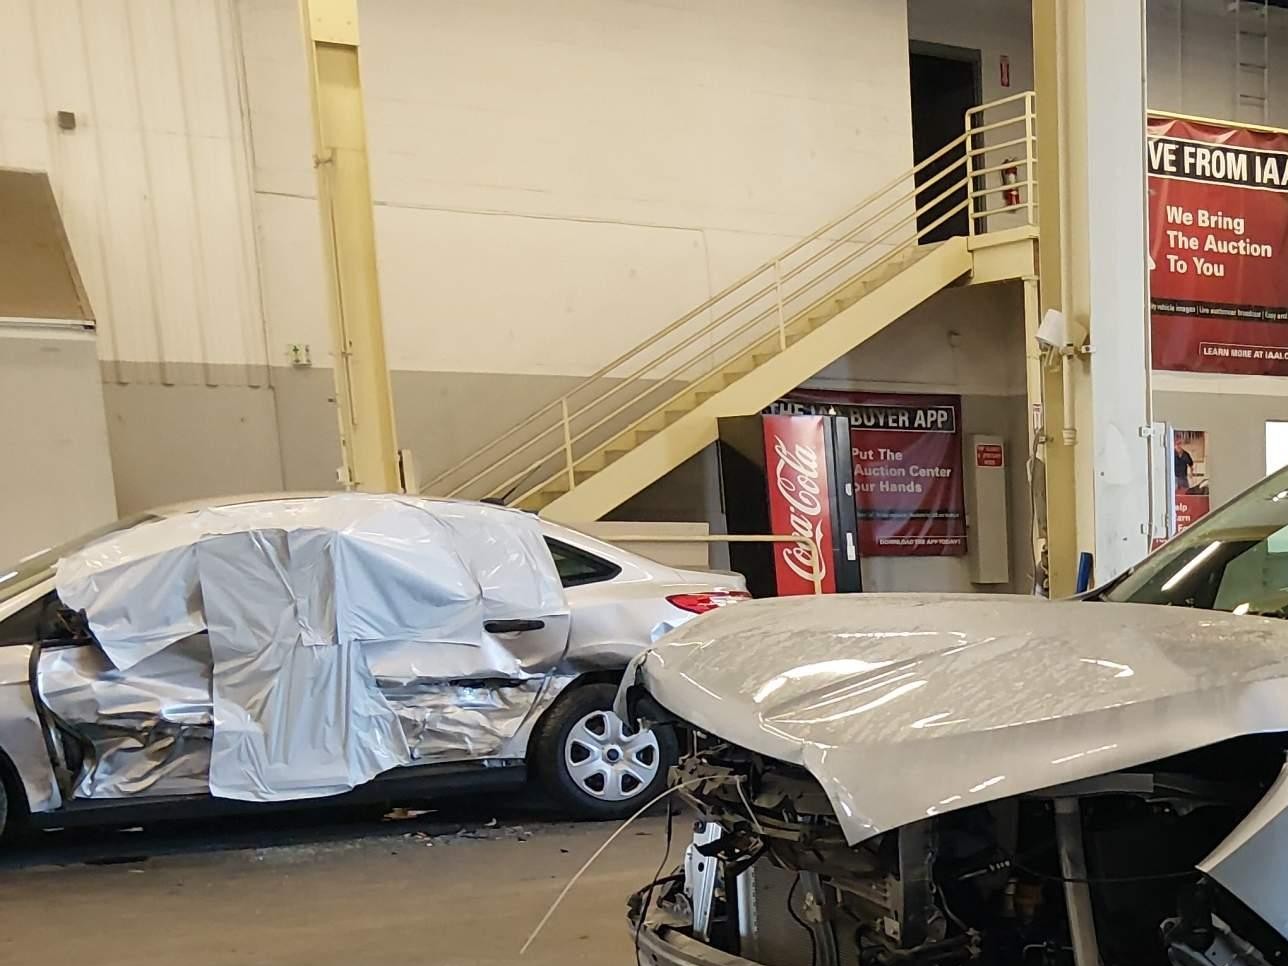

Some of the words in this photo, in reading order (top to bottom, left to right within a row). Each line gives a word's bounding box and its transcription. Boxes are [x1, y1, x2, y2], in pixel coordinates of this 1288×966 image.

[1183, 147, 1248, 181] FROM
[1166, 205, 1193, 225] We
[1198, 209, 1245, 234] Bring
[1166, 230, 1199, 250] The
[1204, 234, 1272, 257] Auction
[1166, 254, 1187, 273] To
[1193, 256, 1225, 276] You
[1203, 347, 1229, 357] LEARN
[1230, 349, 1252, 358] MORE
[1253, 350, 1264, 359] AT
[850, 408, 910, 428] BUYER
[913, 409, 948, 428] APP
[852, 447, 874, 460] Put
[878, 448, 903, 461] The
[853, 463, 906, 477] Auction
[909, 465, 952, 477] Center
[880, 481, 923, 493] Hands
